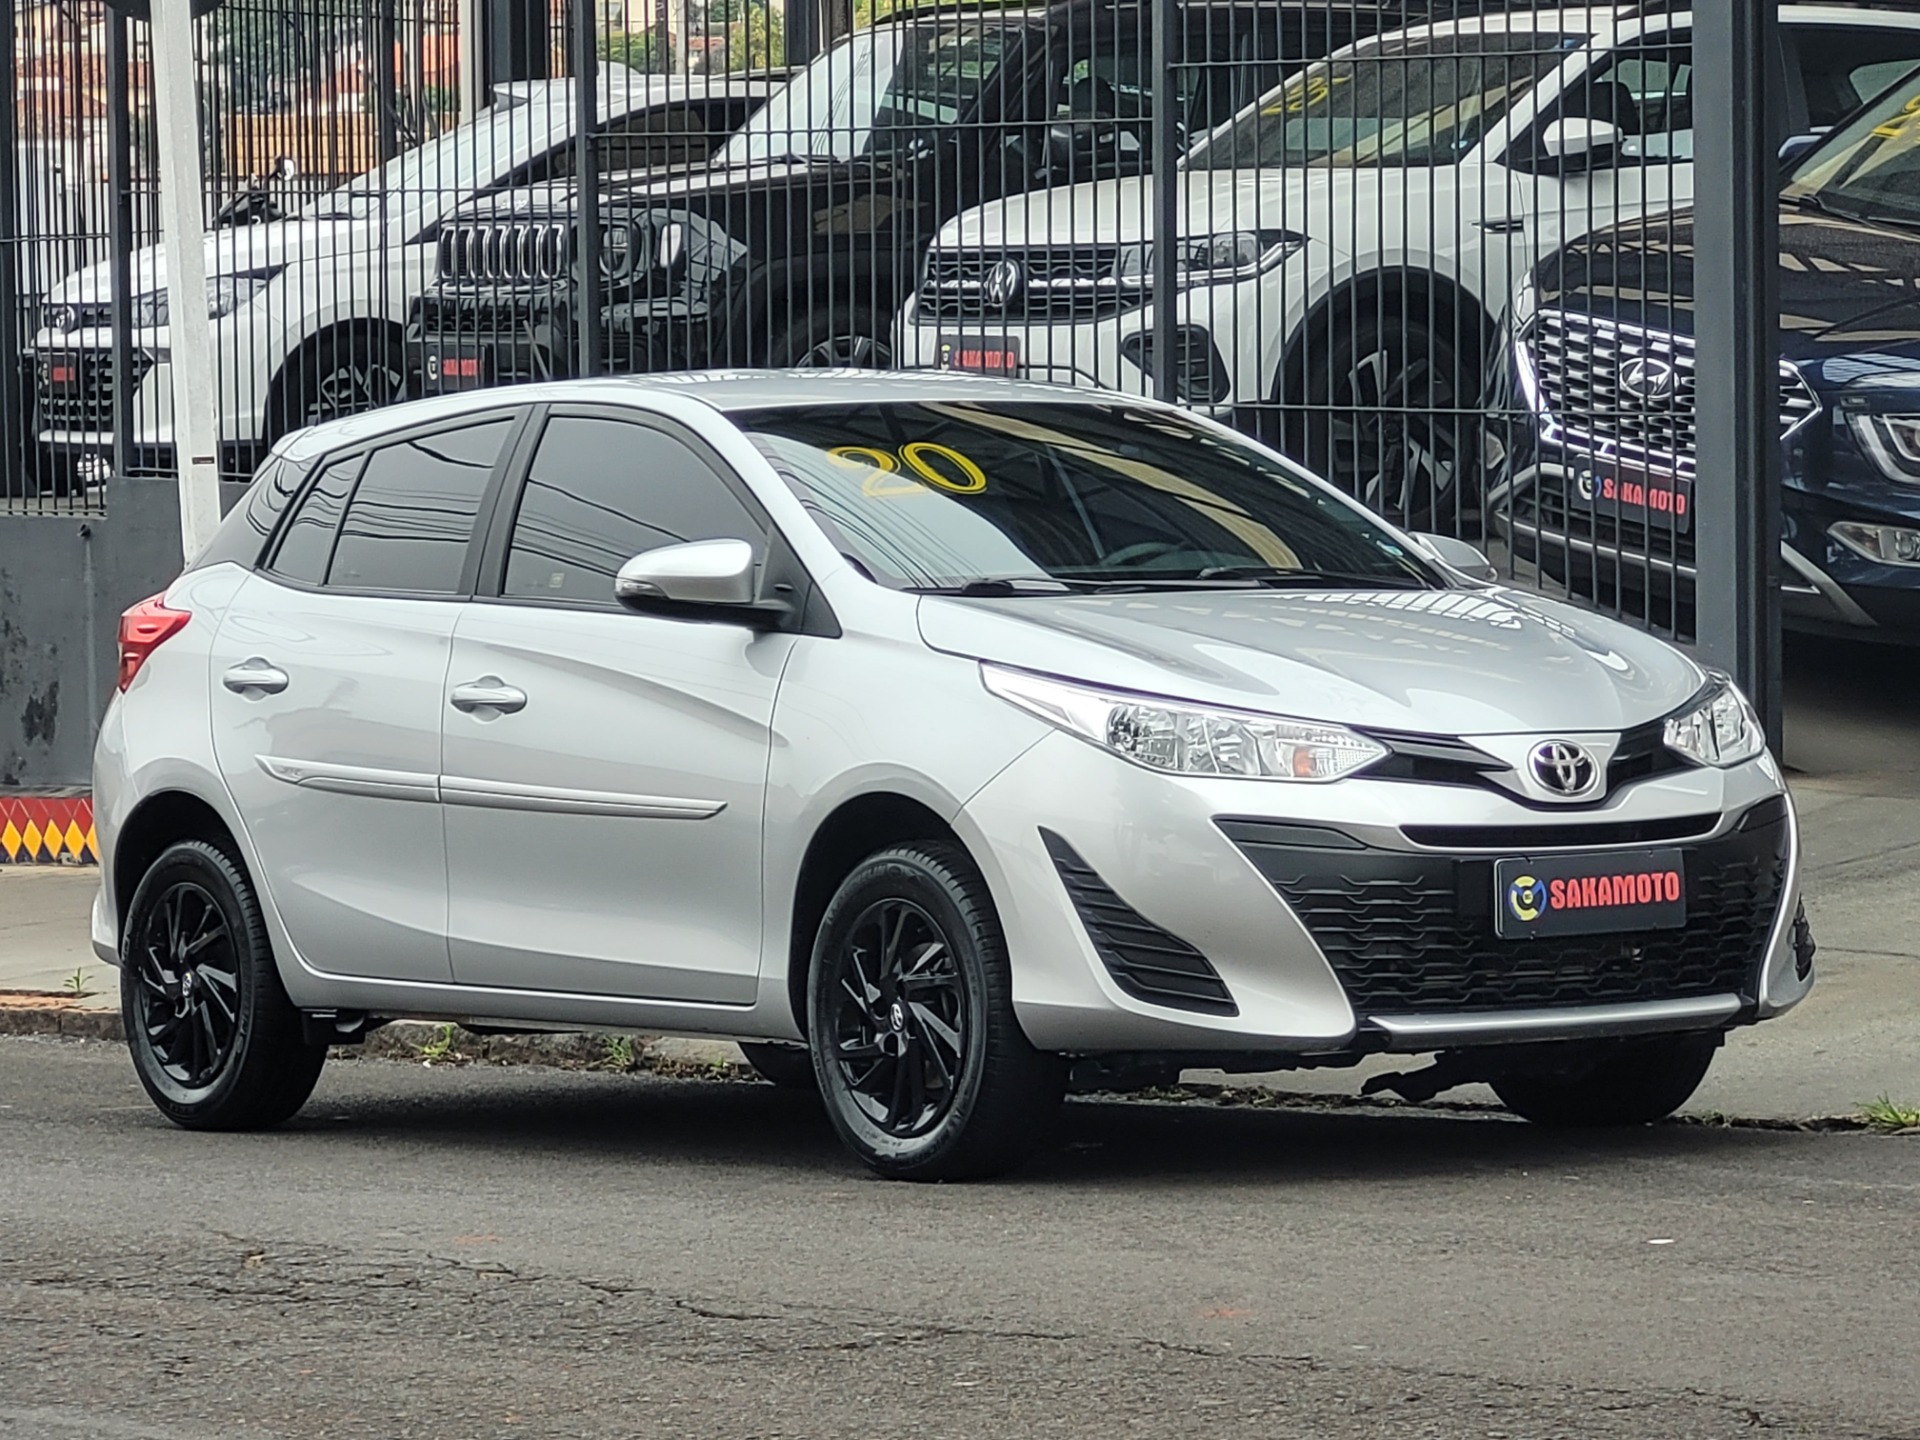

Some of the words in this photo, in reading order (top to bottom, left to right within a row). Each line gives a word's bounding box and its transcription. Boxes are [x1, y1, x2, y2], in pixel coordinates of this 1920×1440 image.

[954, 350, 1015, 369] SAKAMOO
[826, 442, 988, 497] 20
[1550, 871, 1681, 910] SAKAMOTO
